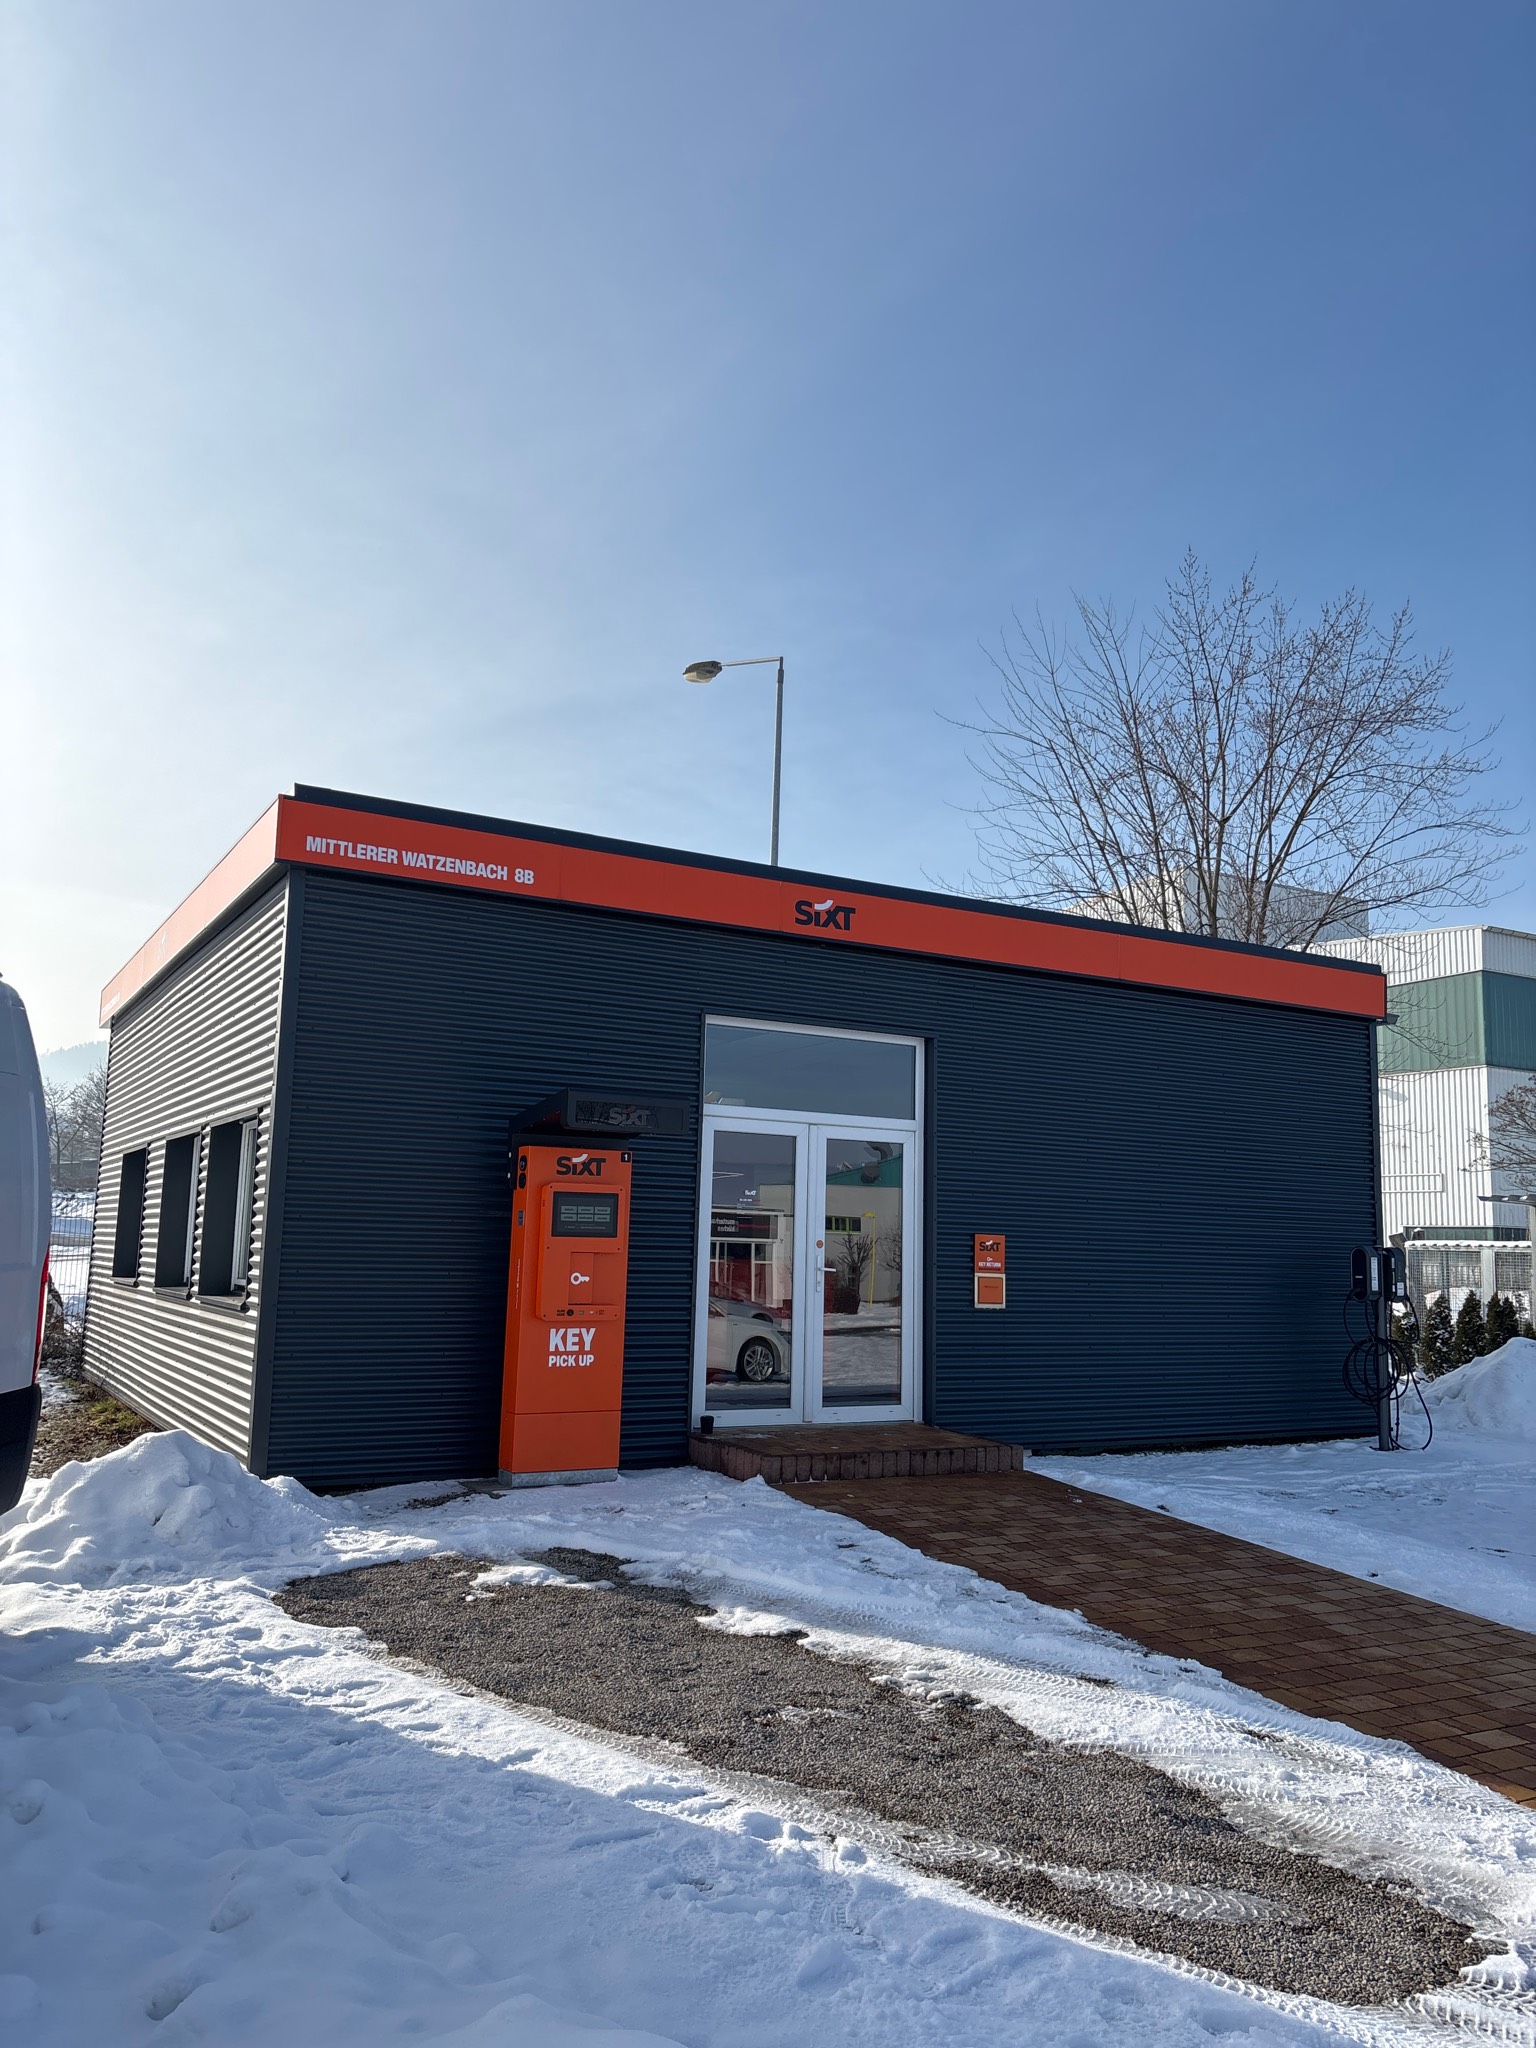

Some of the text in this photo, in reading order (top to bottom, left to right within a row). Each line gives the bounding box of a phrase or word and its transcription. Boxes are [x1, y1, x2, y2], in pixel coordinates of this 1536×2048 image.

[306, 835, 534, 885] MITTLERER WATZENBACH 8B
[795, 899, 856, 931] SIXT
[608, 1105, 651, 1126] SIXT
[556, 1153, 606, 1176] SIXT
[623, 1153, 628, 1161] 1
[979, 1239, 1001, 1252] SIXT
[549, 1328, 596, 1352] KEY
[548, 1354, 595, 1367] PICK UP
